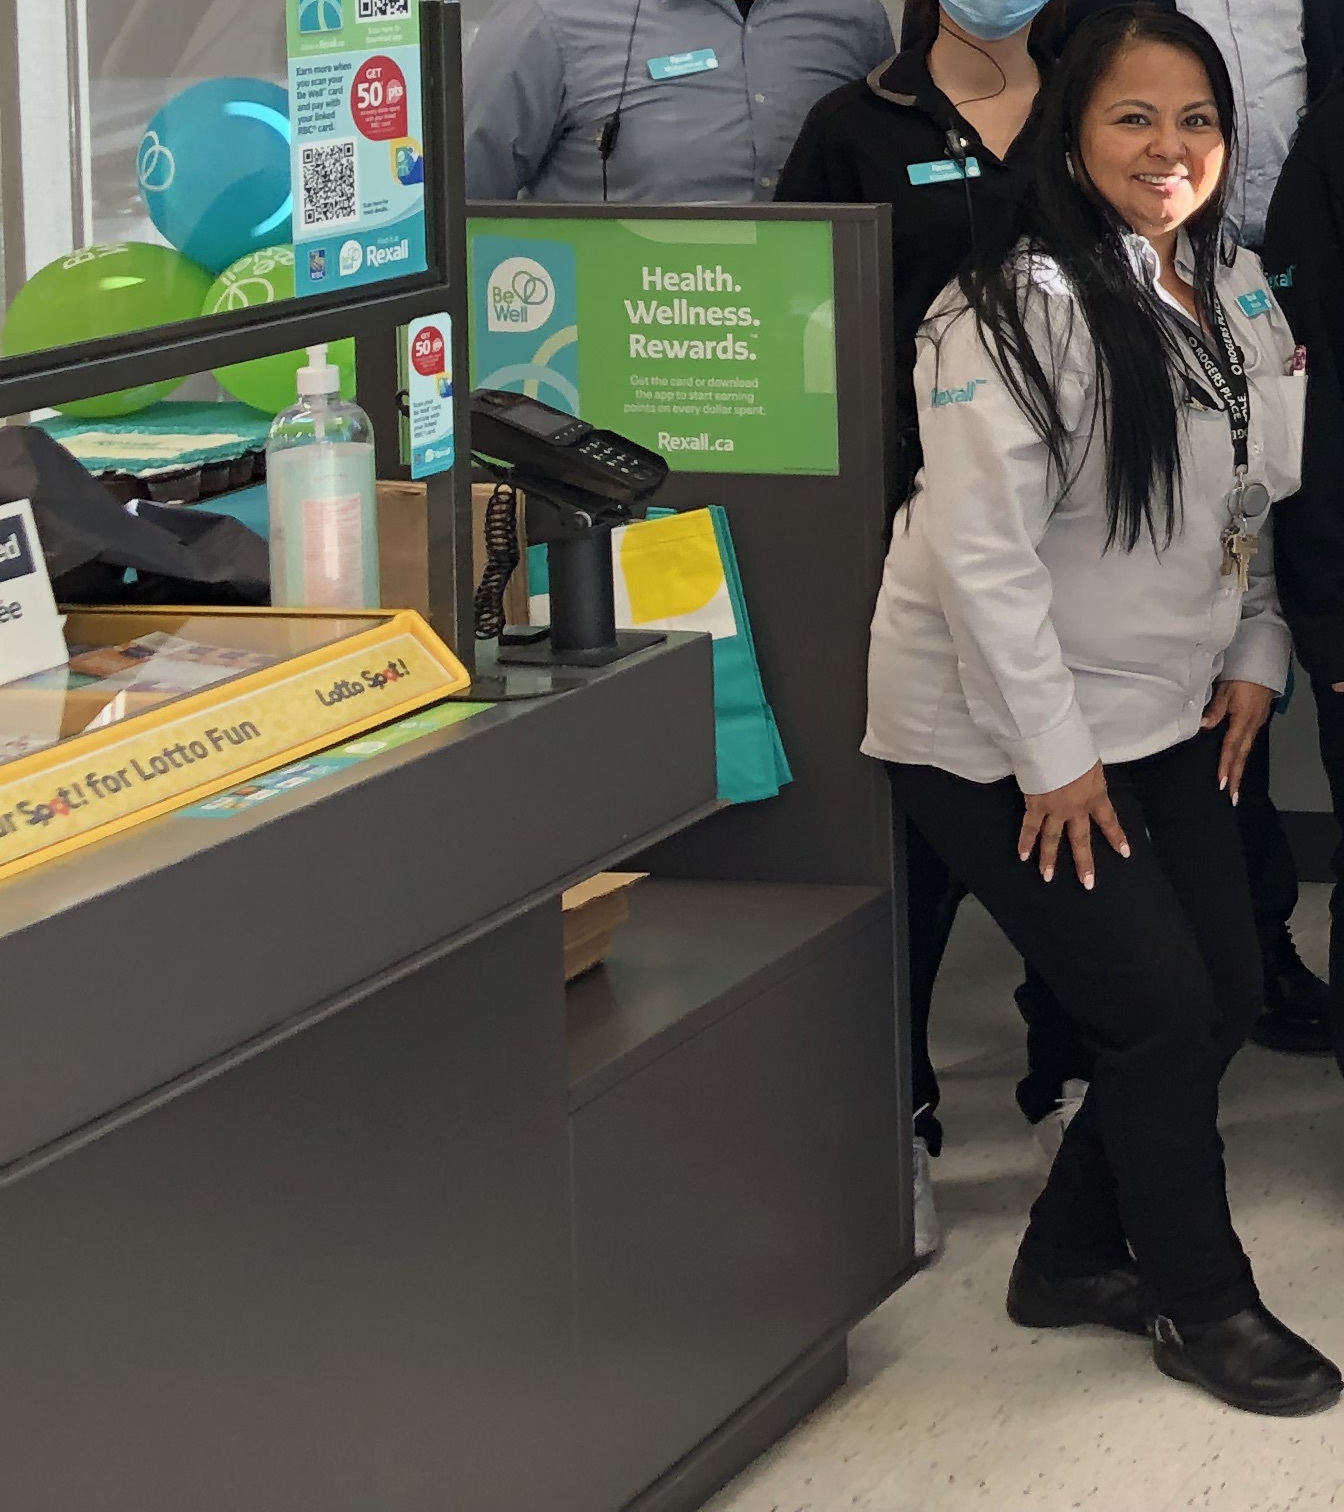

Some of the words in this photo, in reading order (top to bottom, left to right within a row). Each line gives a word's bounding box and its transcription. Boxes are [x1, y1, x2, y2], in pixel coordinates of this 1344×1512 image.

[296, 67, 313, 77] Earn
[314, 65, 332, 74] more
[333, 63, 352, 72] when
[365, 68, 382, 80] GET
[296, 80, 311, 90] you
[311, 78, 327, 87] scan
[328, 76, 344, 86] your
[328, 87, 344, 96] card
[357, 81, 383, 109] 50
[297, 103, 311, 112] and
[325, 98, 341, 107] with
[297, 116, 314, 126] your
[366, 239, 409, 267] Rexall
[642, 265, 742, 293] Health.
[492, 286, 515, 305] Be
[494, 305, 529, 324] Well
[623, 299, 761, 328] Wellness.
[415, 339, 431, 356] 50
[629, 333, 757, 362] Rewards.
[630, 374, 649, 387] Get
[651, 376, 669, 387] the
[670, 376, 693, 388] card
[695, 377, 706, 388] or
[708, 376, 759, 389] download
[1195, 346, 1226, 388] ROGERS
[1220, 386, 1242, 423] PLACE
[635, 389, 653, 400] the
[654, 391, 675, 403] app
[676, 390, 687, 400] to
[689, 390, 713, 401] start
[714, 391, 755, 404] earning
[623, 402, 656, 414] points
[657, 404, 671, 414] on
[672, 405, 701, 416] every
[702, 403, 732, 415] dollar
[658, 431, 735, 452] Rexall.ca
[315, 678, 365, 707] Lotto
[360, 658, 410, 691] Spot!
[16, 781, 89, 827] Spot!
[86, 771, 133, 799] for
[130, 740, 209, 782] Lotto
[204, 720, 262, 753] Fun
